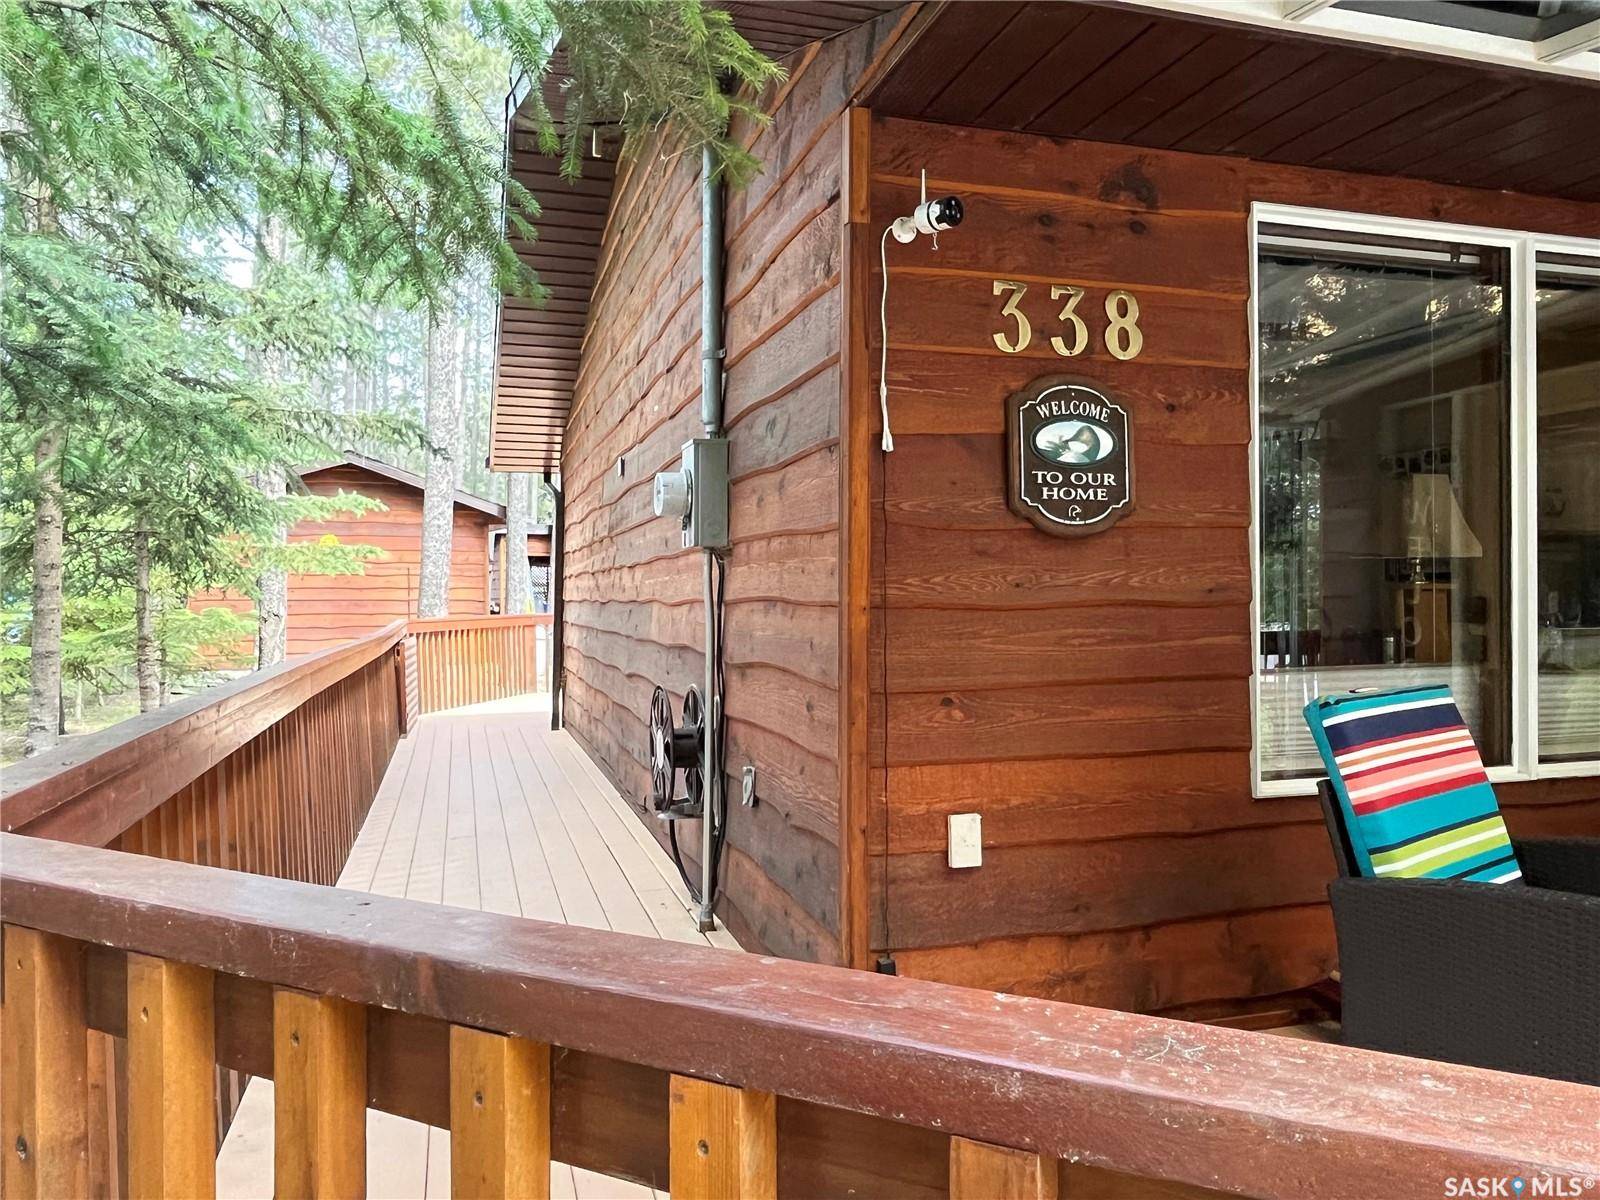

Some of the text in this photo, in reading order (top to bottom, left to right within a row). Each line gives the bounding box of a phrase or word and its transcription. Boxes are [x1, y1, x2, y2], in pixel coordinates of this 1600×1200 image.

[993, 279, 1144, 361] 338
[1036, 400, 1111, 423] WELCOME
[1032, 470, 1117, 486] TO OUR
[1041, 487, 1109, 501] HOME
